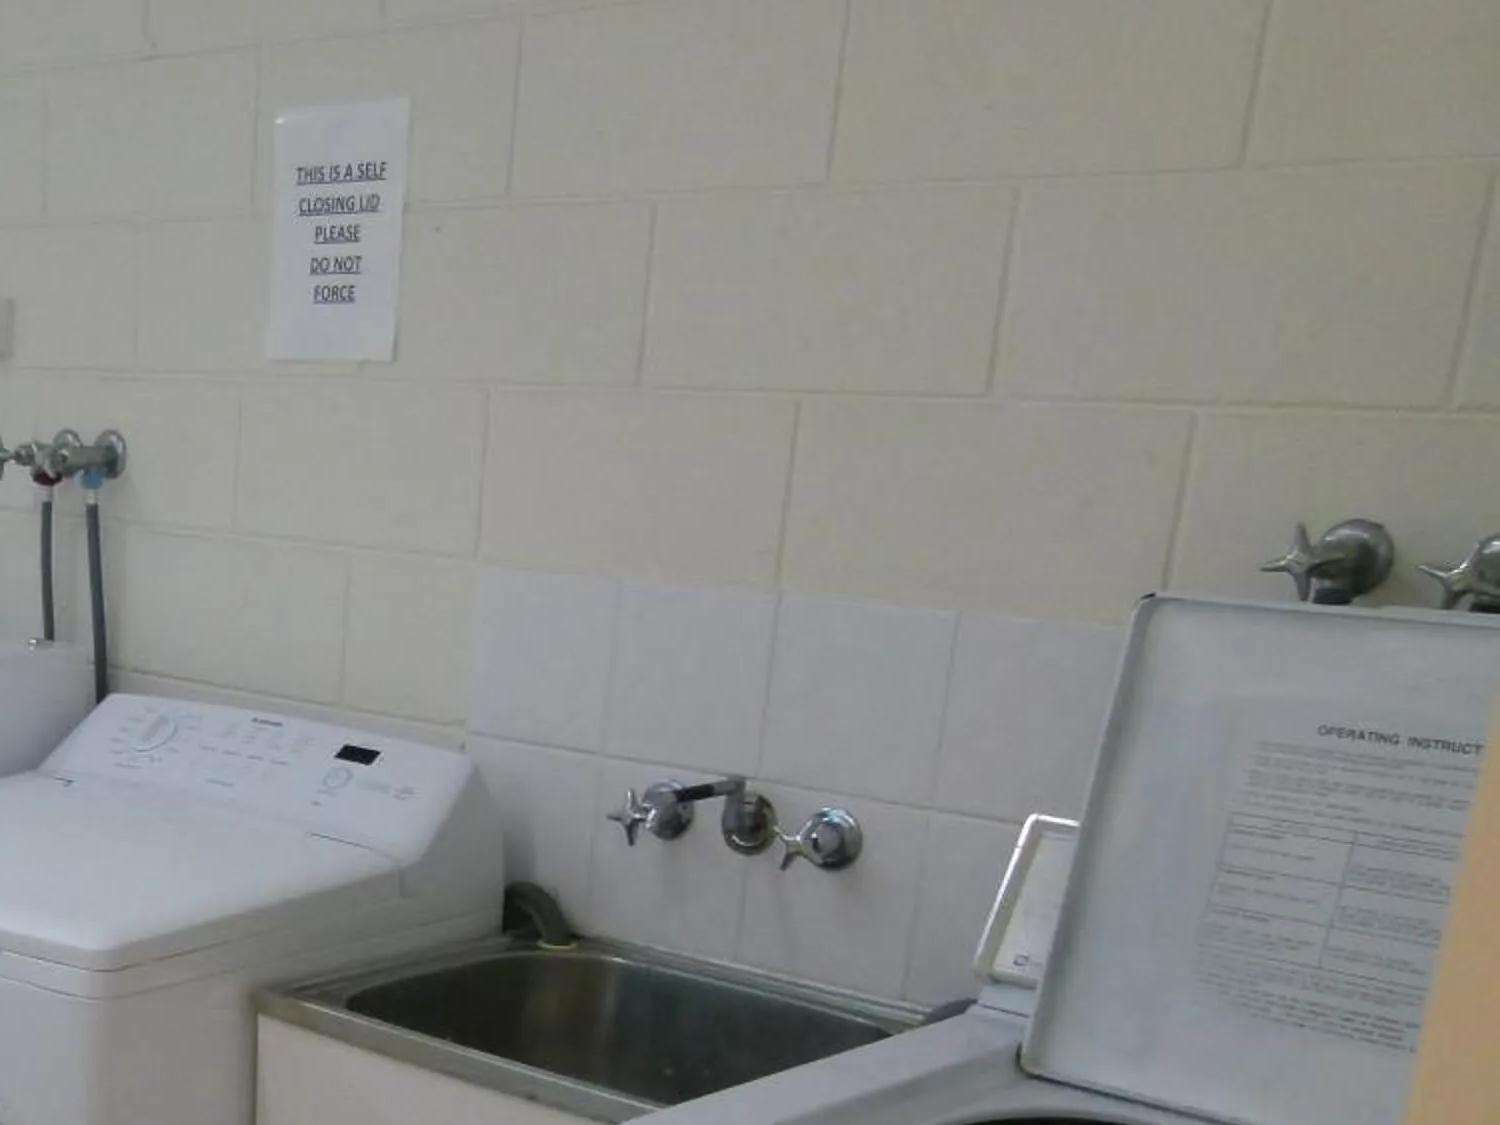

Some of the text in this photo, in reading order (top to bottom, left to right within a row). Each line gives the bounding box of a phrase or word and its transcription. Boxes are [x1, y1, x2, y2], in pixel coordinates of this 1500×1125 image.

[296, 161, 388, 185] THIS IS A SELF
[298, 193, 382, 216] CLOSING LID
[314, 224, 361, 243] PLEASE
[309, 256, 363, 275] DO NOT
[313, 285, 357, 304] FORCE
[1317, 725, 1401, 747] OPERATING
